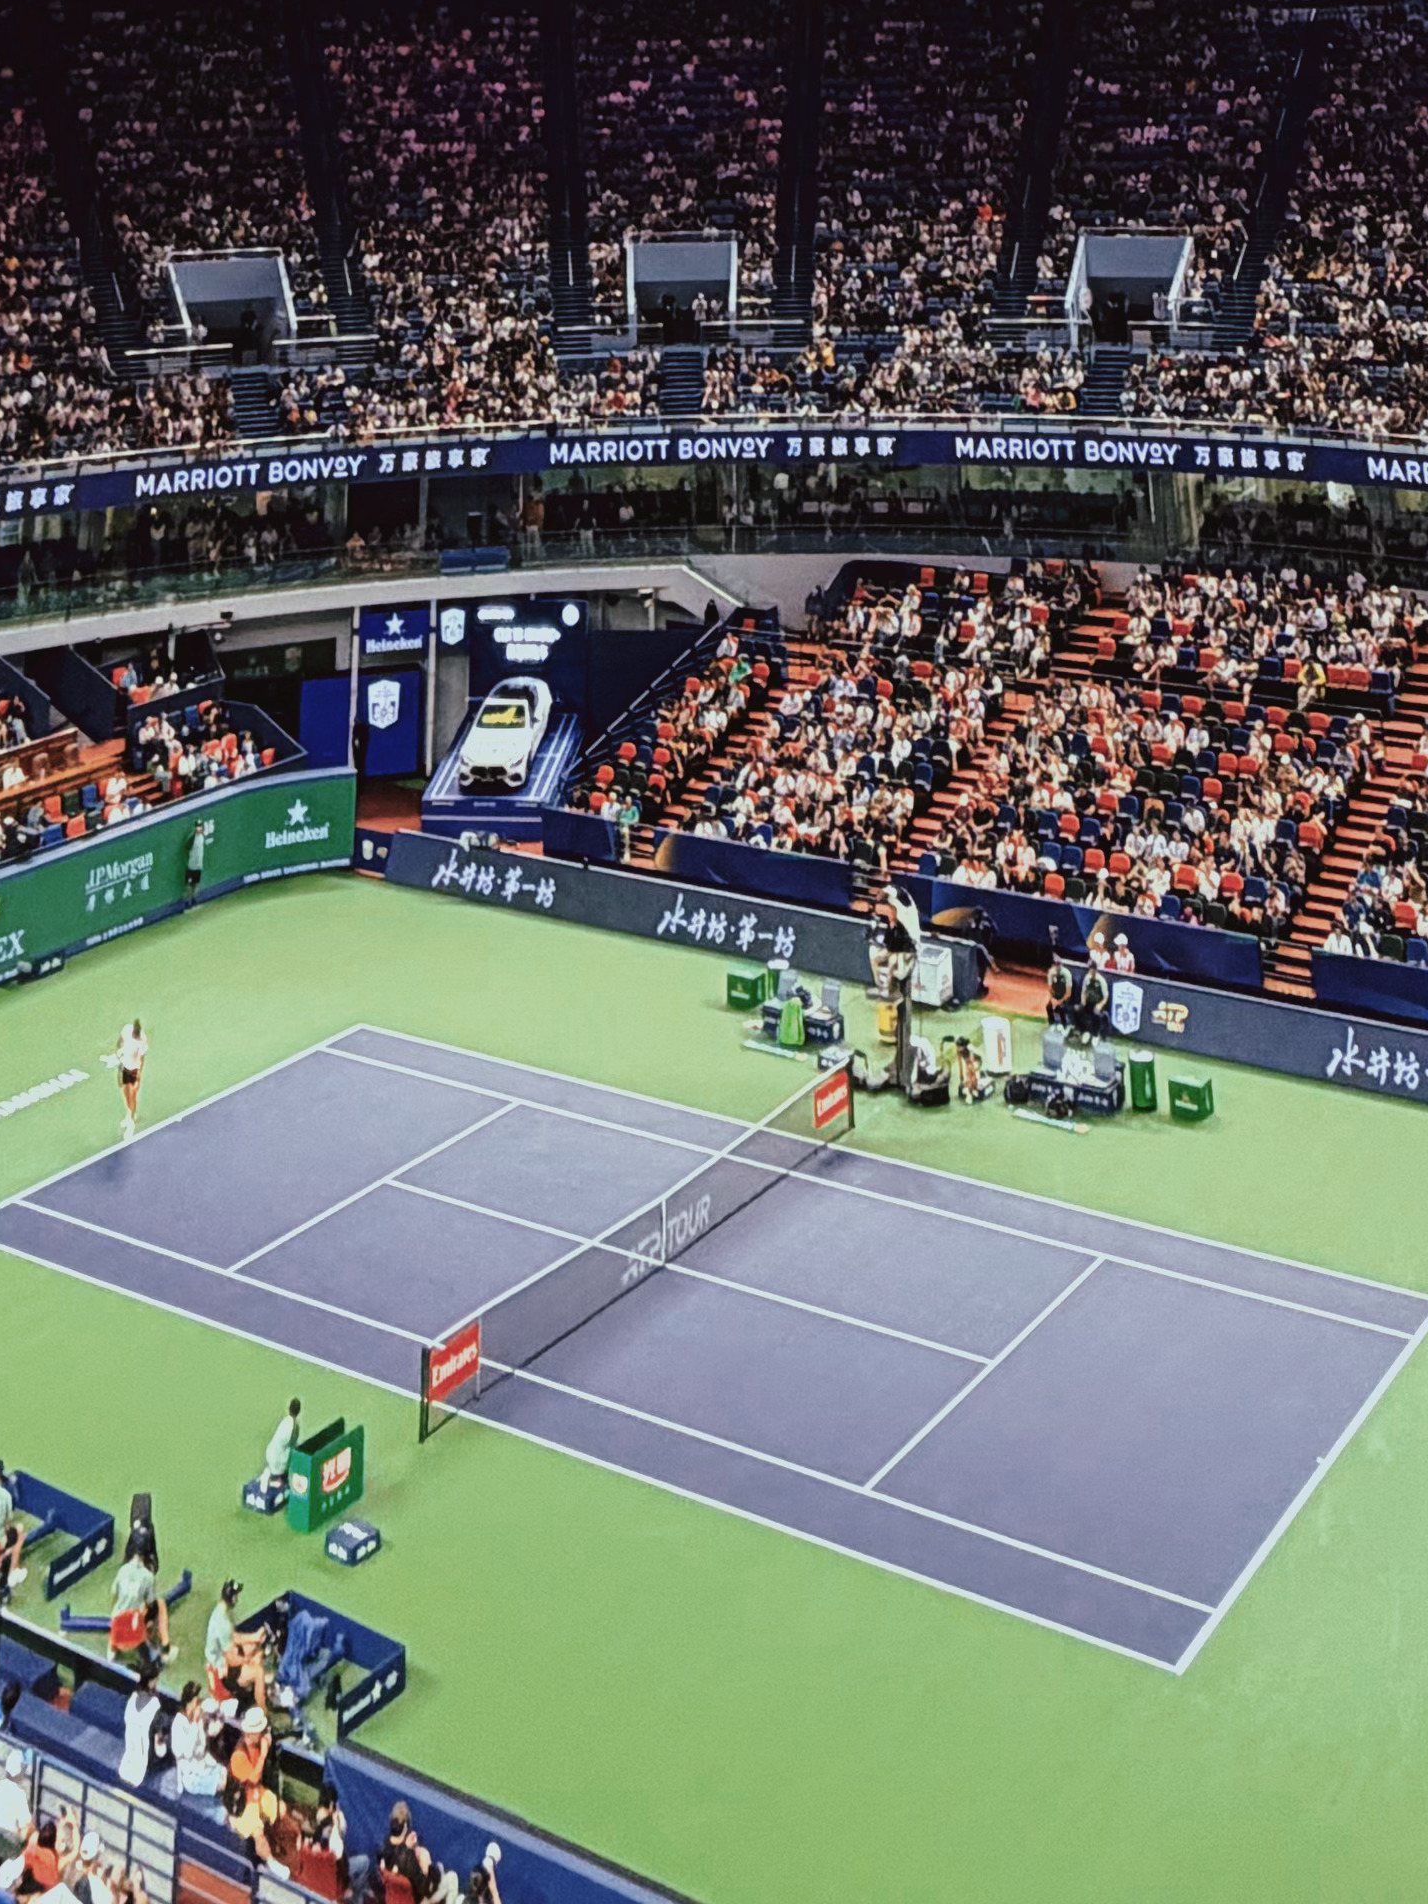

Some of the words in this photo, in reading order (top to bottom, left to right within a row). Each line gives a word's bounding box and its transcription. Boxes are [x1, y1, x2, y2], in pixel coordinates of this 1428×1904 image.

[549, 438, 671, 465] MARRIOTT
[678, 436, 775, 460] BONVOY
[955, 436, 1077, 462] MARRIOTT
[1084, 440, 1182, 465] BONVOY
[135, 463, 261, 498] MARRIOTT
[268, 454, 368, 488] BONVOY
[264, 821, 331, 849] Heineken
[667, 1193, 712, 1254] TOUR
[431, 1341, 478, 1388] Emirates
